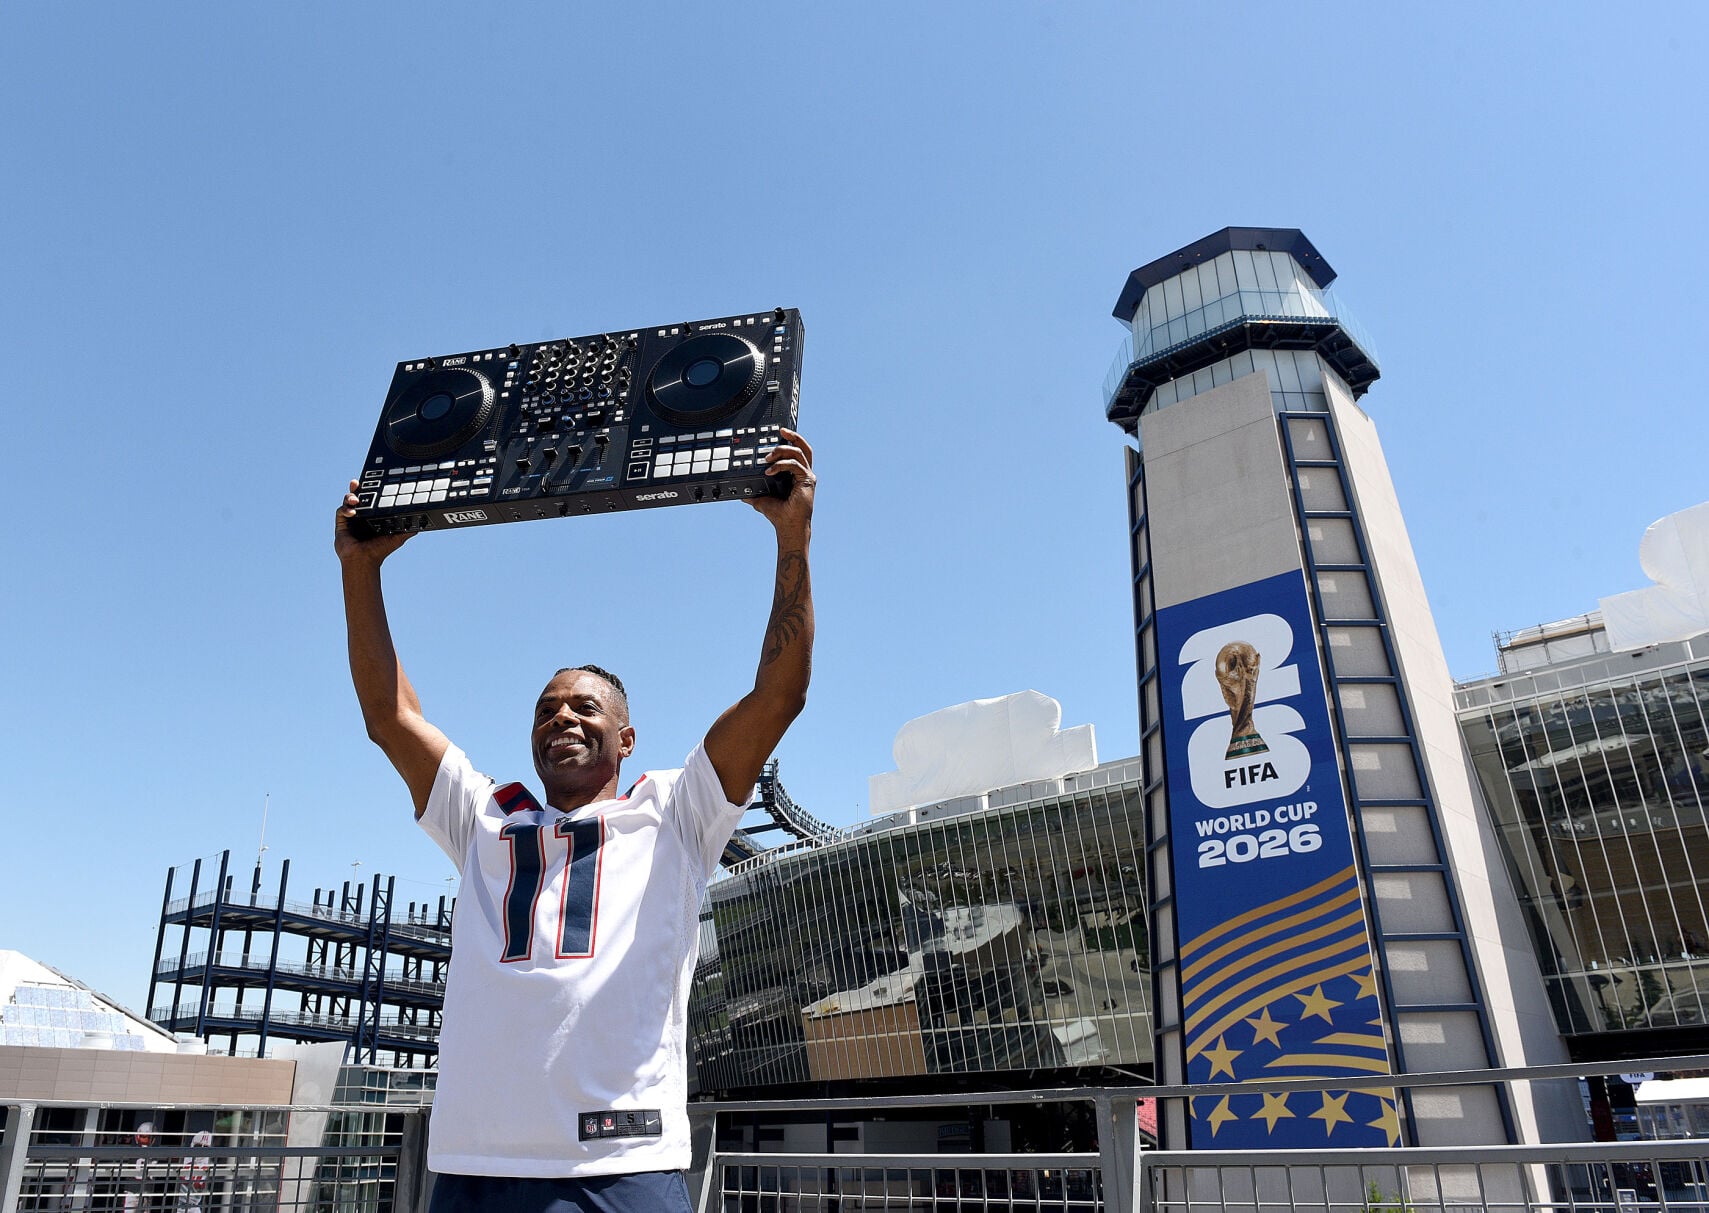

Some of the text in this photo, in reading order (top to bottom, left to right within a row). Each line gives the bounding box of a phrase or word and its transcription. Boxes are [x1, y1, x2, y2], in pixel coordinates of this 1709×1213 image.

[699, 322, 727, 331] serato
[635, 490, 679, 502] serato
[443, 510, 487, 524] RANE
[1224, 761, 1279, 789] FIFA
[1195, 801, 1318, 837] WORLD CUP
[1197, 823, 1323, 869] 2026
[499, 815, 605, 963] 11
[626, 1113, 635, 1124] S
